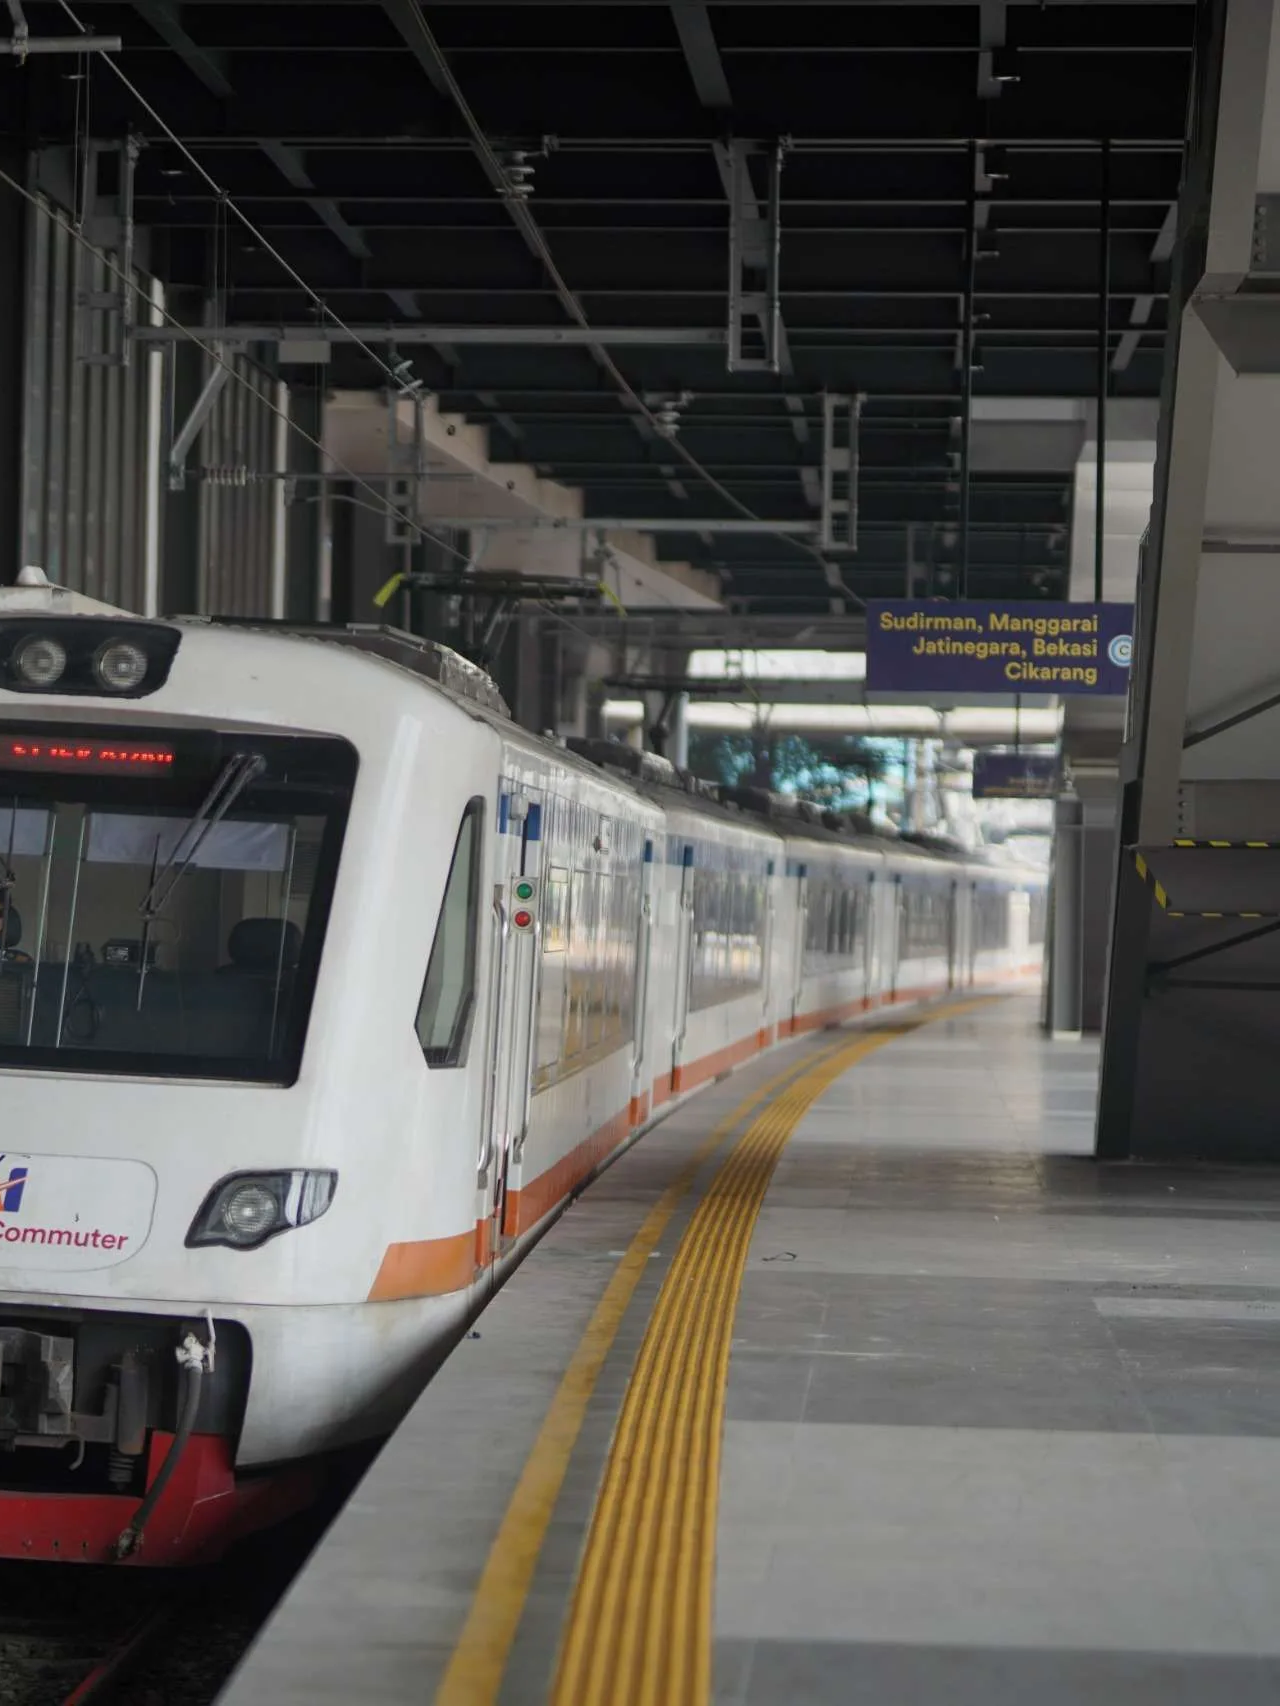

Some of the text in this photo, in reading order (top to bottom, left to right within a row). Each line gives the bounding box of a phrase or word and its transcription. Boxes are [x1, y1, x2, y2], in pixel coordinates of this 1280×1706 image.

[880, 612, 1098, 635] Sudirman, Manggarai
[913, 637, 1098, 659] Jatinegara, Bekasi
[1005, 661, 1098, 684] Cikarang
